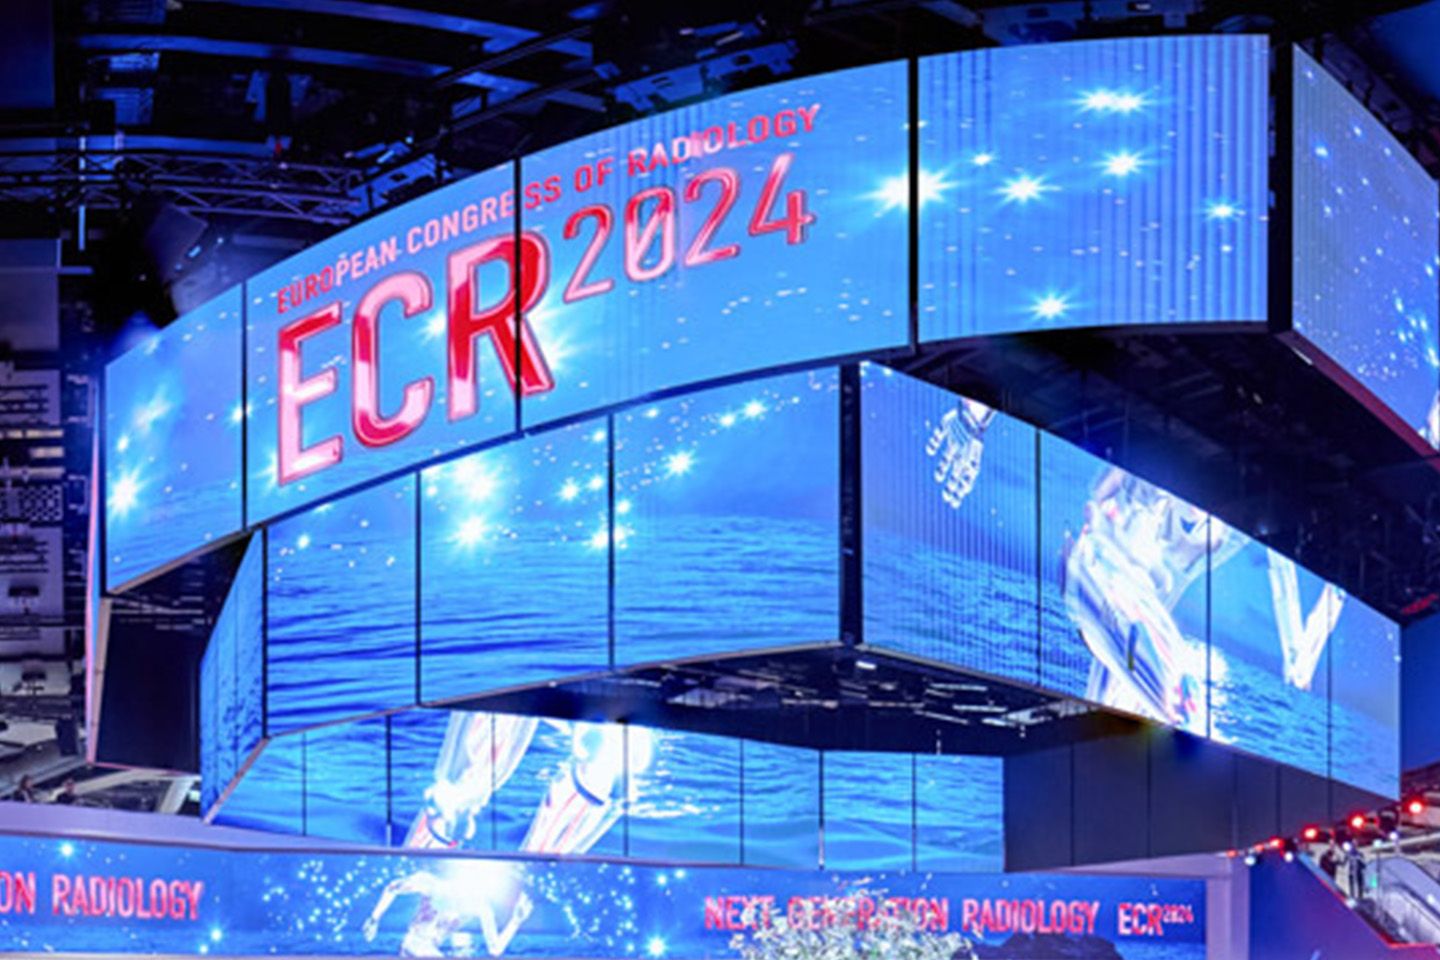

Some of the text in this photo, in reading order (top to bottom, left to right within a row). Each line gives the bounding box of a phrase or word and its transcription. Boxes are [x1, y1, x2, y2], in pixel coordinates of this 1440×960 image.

[277, 103, 821, 313] EUROPEAN CONGRESS OF RADIOLOGY
[52, 874, 204, 920] RADIOLOGY
[704, 896, 775, 930] NEXT
[962, 898, 1099, 934] RADIOLOGY
